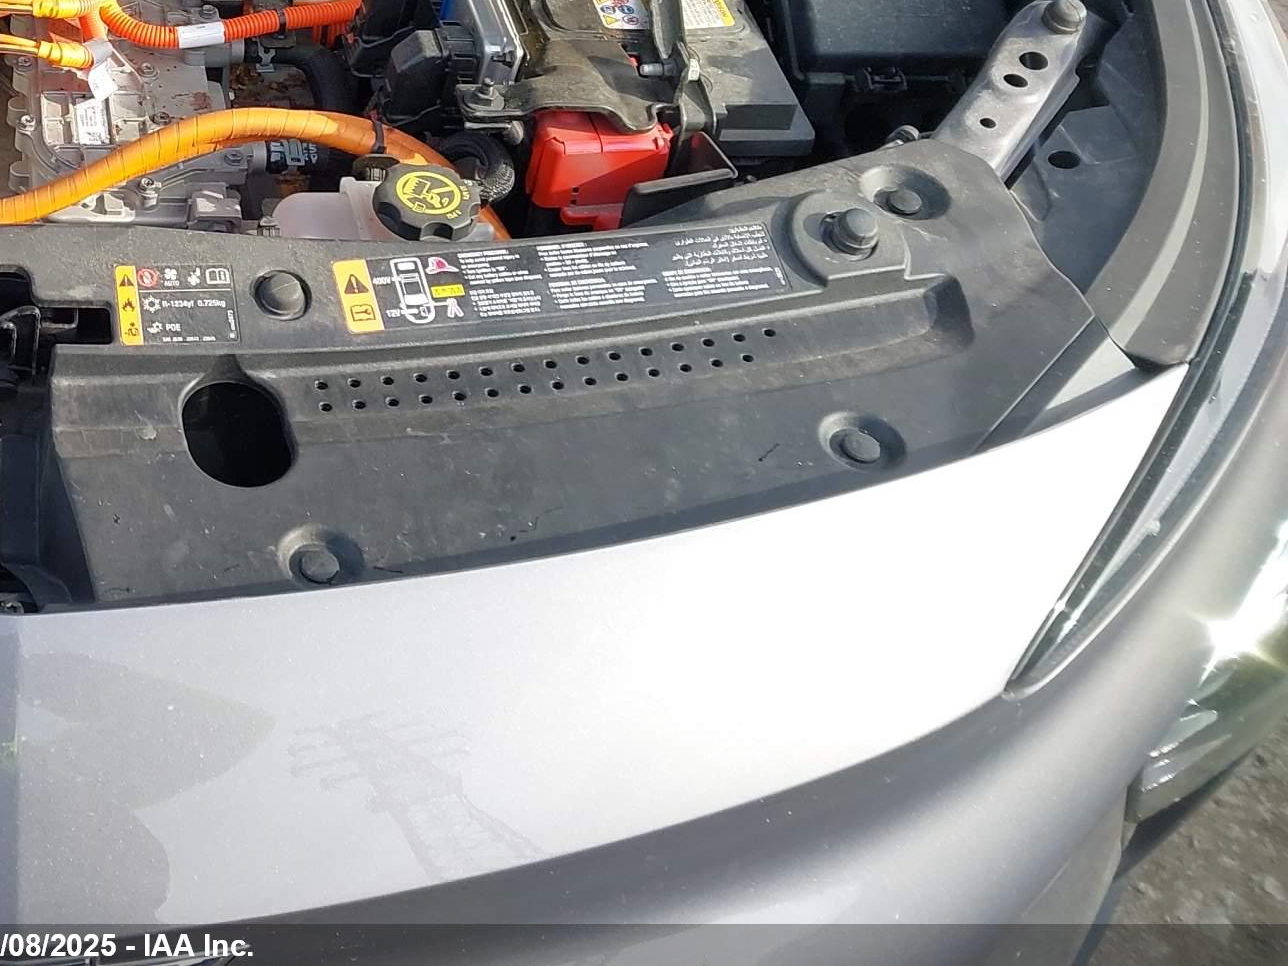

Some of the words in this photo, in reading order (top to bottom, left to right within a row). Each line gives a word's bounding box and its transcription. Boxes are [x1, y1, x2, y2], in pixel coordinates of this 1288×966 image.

[197, 299, 226, 308] 0.725kg
[386, 309, 401, 318] 12V
[165, 323, 182, 332] POE
